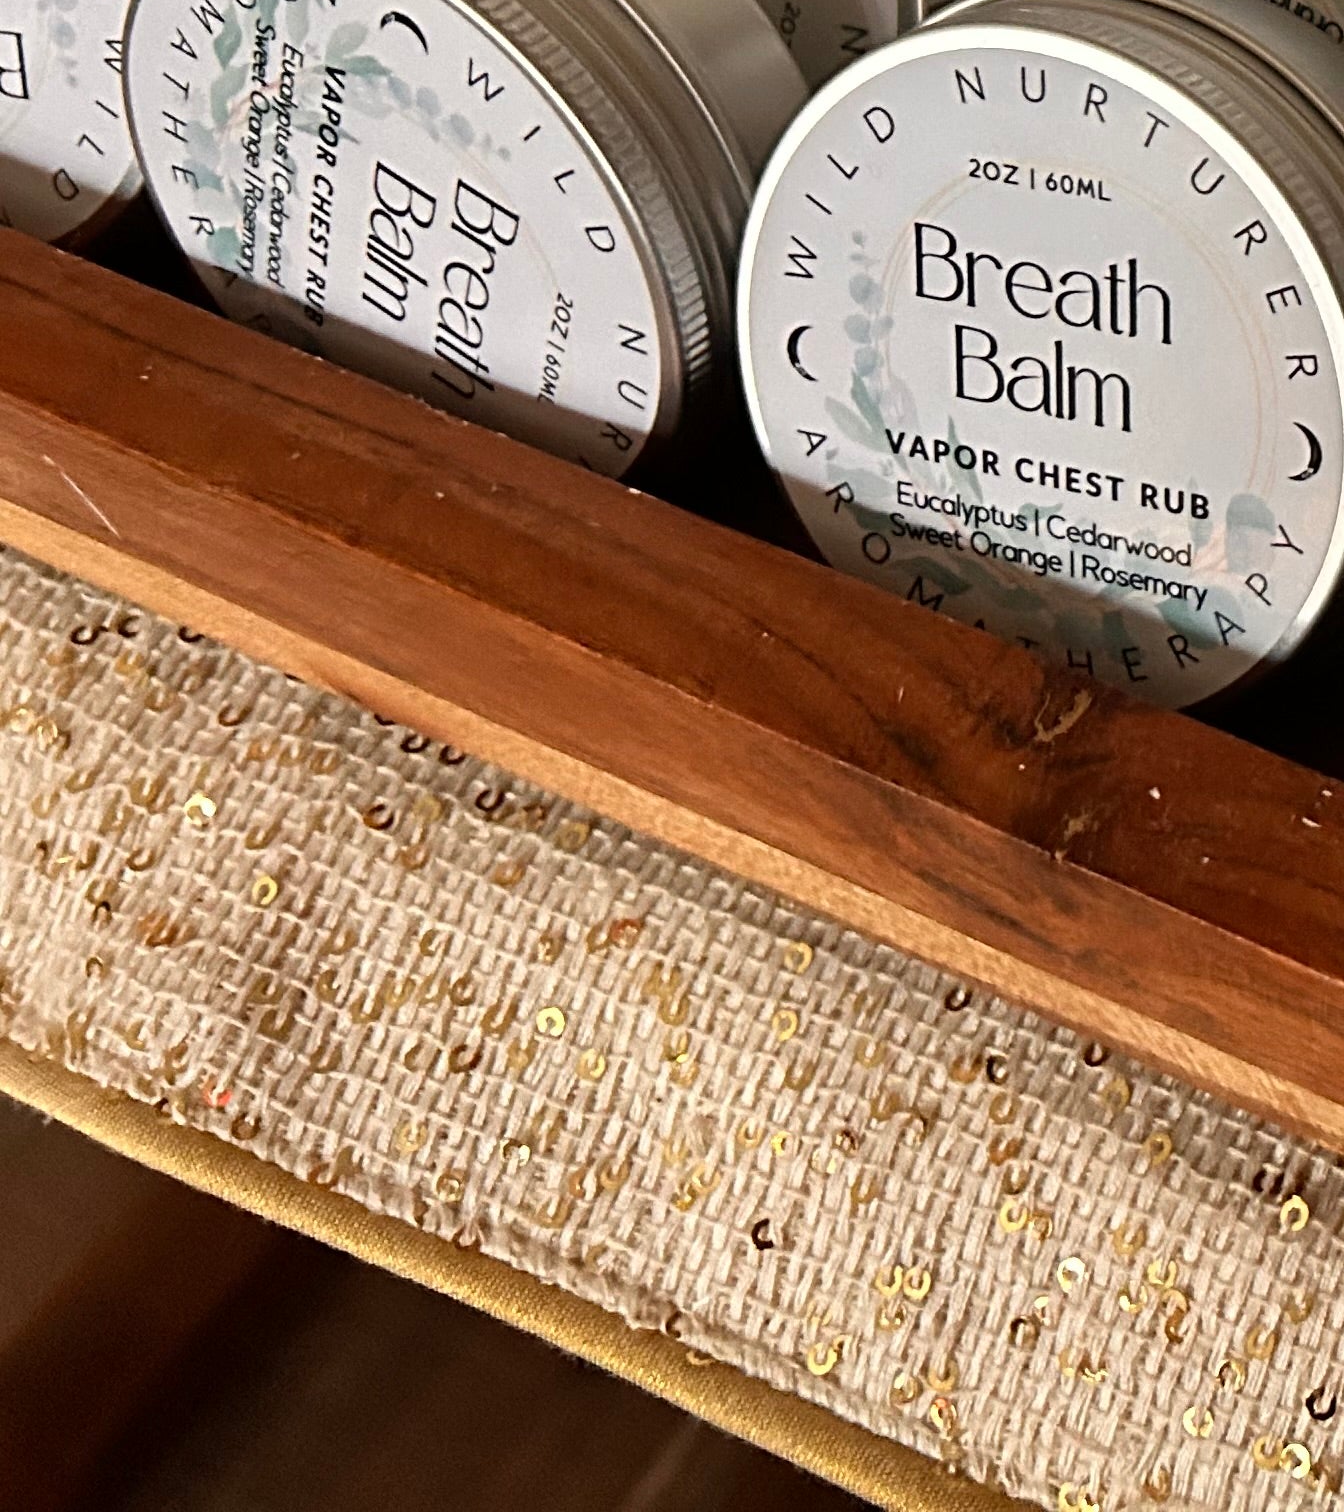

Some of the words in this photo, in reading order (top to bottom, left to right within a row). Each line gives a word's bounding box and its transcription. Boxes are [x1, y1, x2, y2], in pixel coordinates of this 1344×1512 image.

[250, 18, 278, 87] Sweet
[272, 42, 305, 157] Eucalyptus
[243, 88, 271, 168] Orange
[315, 65, 347, 166] VAPOR
[467, 57, 617, 255] WILD
[263, 172, 294, 290] Cedarwood
[307, 173, 336, 274] CHEST
[784, 104, 896, 281] WILD
[953, 64, 1319, 380] NURTURER
[1045, 168, 1113, 203] 60ML
[361, 160, 439, 326] Balm
[431, 178, 522, 404] Breath
[912, 221, 1173, 345] Breath
[300, 272, 330, 330] RUB
[953, 324, 1133, 433] Balm
[884, 428, 1001, 477] VAPOR
[1015, 456, 1125, 503] CHEST
[1139, 481, 1212, 521] RUB
[896, 480, 1029, 535] Eucalyptus
[1046, 517, 1193, 568] Cedarwood
[796, 426, 1305, 683] AROMHERAPY
[889, 511, 966, 554] Sweet
[969, 527, 1063, 577] Orange
[1080, 555, 1209, 611] Rosemary
